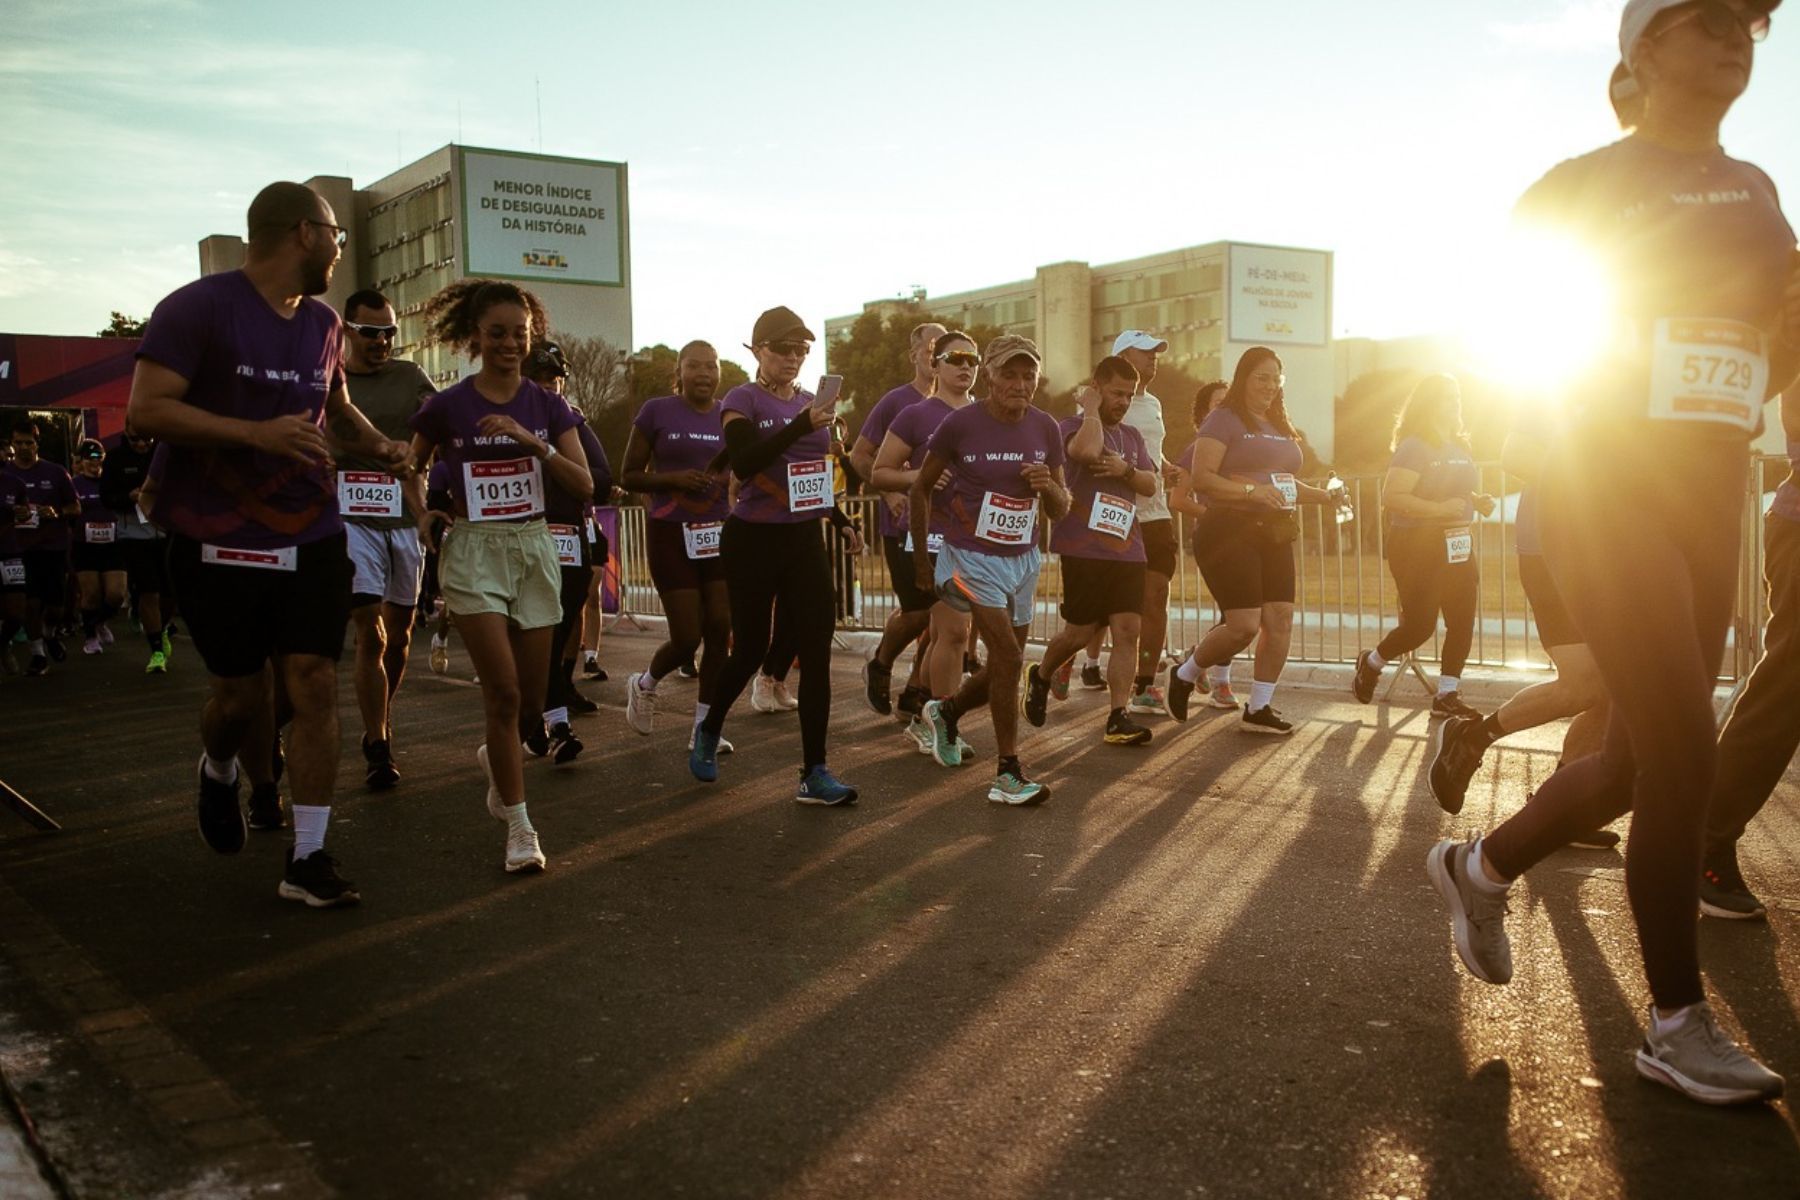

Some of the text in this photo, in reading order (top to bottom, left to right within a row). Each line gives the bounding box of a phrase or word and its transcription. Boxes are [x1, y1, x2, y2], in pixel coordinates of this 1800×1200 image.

[493, 180, 592, 201] MENOR ÍNDICE
[1671, 192, 1704, 205] VAI
[1707, 189, 1750, 204] BEM
[481, 197, 605, 220] DE DESIGUALDADE
[502, 217, 587, 236] DA HISTÓRIA
[1680, 354, 1753, 390] 5729
[985, 452, 1001, 462] VAI
[1002, 452, 1024, 462] BEM
[346, 487, 393, 502] 10426
[475, 478, 532, 500] 10131
[792, 477, 825, 495] 10357
[696, 531, 721, 545] 567
